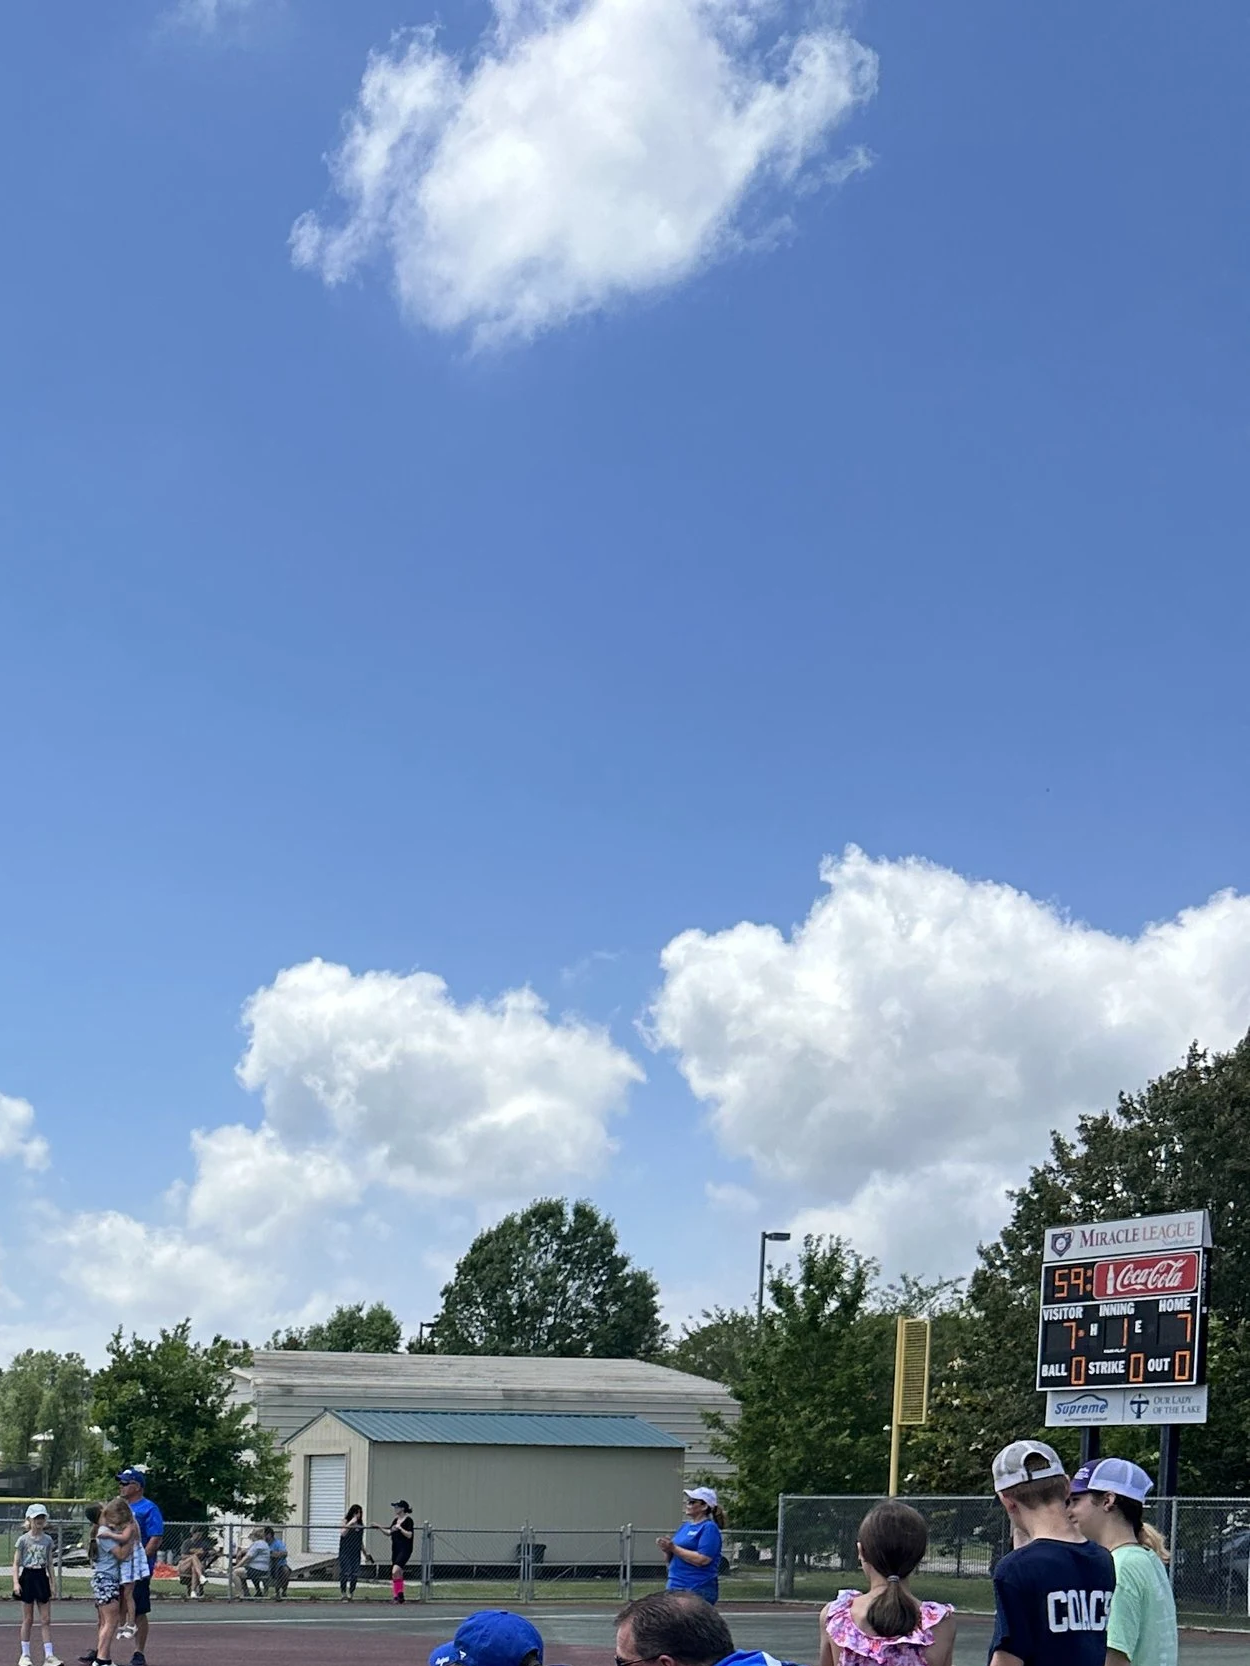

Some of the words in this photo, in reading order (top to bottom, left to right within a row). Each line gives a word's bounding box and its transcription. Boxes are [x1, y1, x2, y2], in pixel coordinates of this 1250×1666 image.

[1080, 1228, 1140, 1248] MIRACLE
[1142, 1221, 1195, 1241] LEAGUE
[1099, 1303, 1135, 1317] INNING
[1158, 1297, 1191, 1312] HOME
[1043, 1306, 1083, 1321] VISITOR
[1089, 1323, 1099, 1336] H
[1134, 1319, 1143, 1333] E
[1176, 1312, 1192, 1343] 7
[1041, 1363, 1068, 1377] BALL
[1070, 1356, 1086, 1385] 0
[1088, 1359, 1126, 1375] STRIKE
[1129, 1352, 1145, 1382] 0
[1147, 1357, 1171, 1372] OUT
[1174, 1350, 1191, 1380] 0
[1055, 1402, 1108, 1416] Supreme
